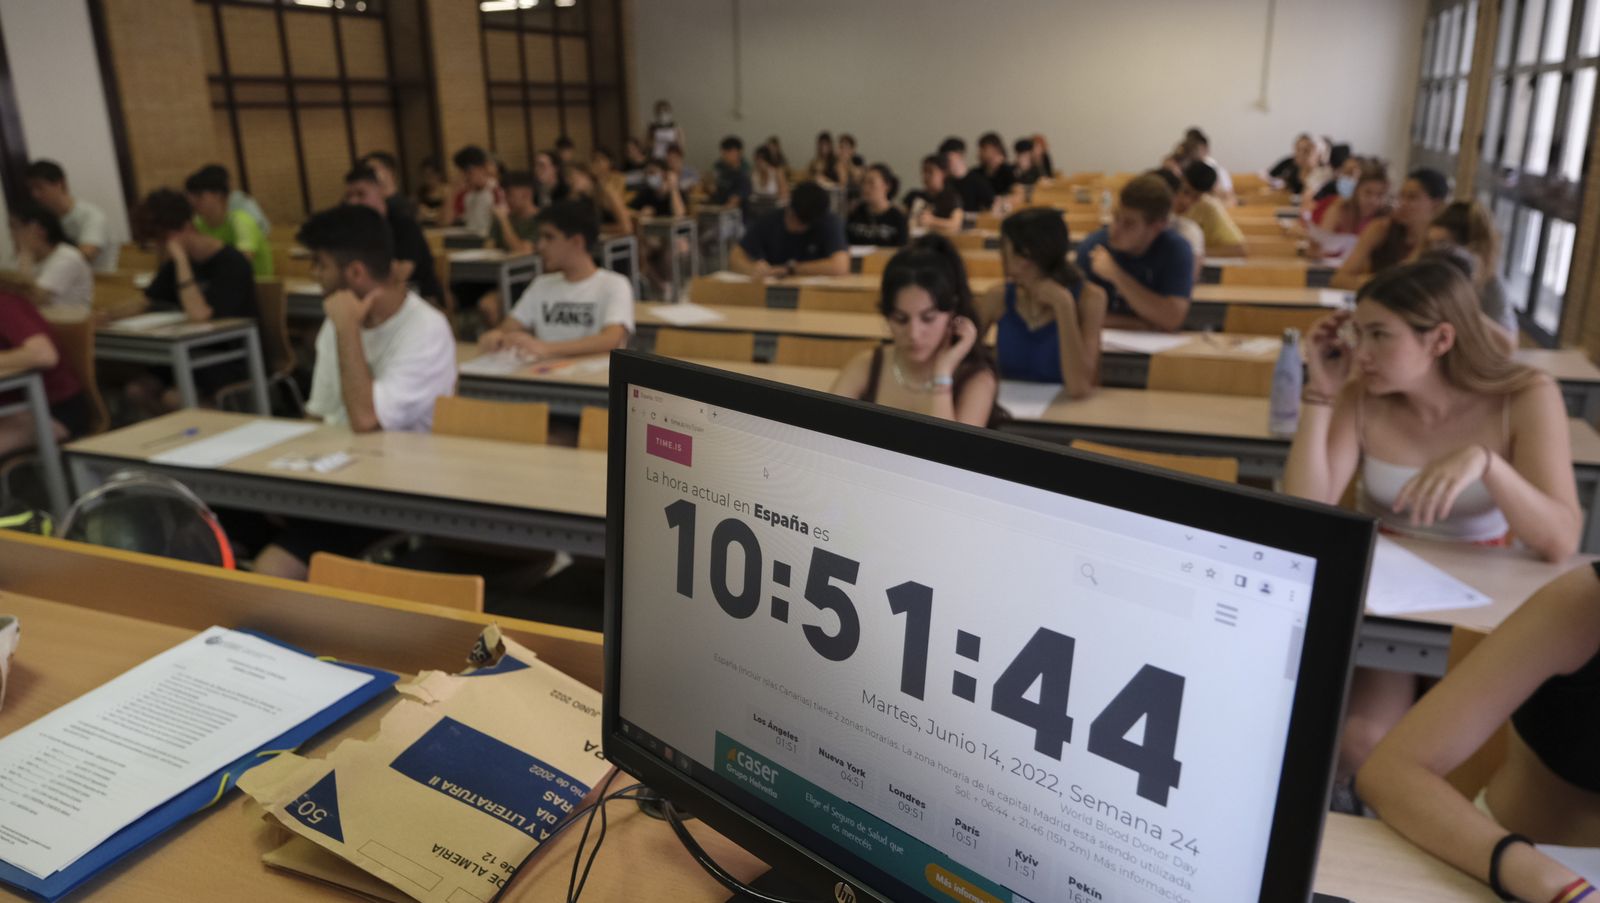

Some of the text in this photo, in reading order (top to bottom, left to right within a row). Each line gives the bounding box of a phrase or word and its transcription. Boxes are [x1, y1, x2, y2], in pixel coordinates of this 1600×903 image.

[543, 302, 595, 327] VANS
[656, 437, 682, 452] TIME.IS
[646, 467, 830, 542] La hora actual en España es
[550, 689, 600, 717] JUNIO 2022
[753, 713, 799, 743] Los Ángeles
[775, 736, 797, 753] 01:51
[528, 764, 556, 782] 2022
[726, 763, 748, 782] Grupo
[737, 750, 780, 785] caser
[818, 747, 866, 778] Nueva York
[862, 689, 1200, 857] Martes, Junio 14, 2022, Semana 24
[556, 775, 570, 788] de
[813, 701, 833, 717] tiene
[834, 711, 839, 721] 2
[840, 715, 864, 733] zonas
[902, 744, 913, 757] La
[914, 753, 935, 768] zona
[937, 762, 970, 784] horaria
[971, 777, 985, 791] de
[986, 784, 995, 796] la
[997, 792, 1031, 813] capital
[1034, 807, 1071, 833] Madrid
[1073, 826, 1096, 845] está
[1100, 839, 1137, 864] siendo
[840, 771, 865, 790] 04:51
[440, 779, 527, 827] LITERATURA
[889, 783, 926, 809] Londres
[298, 800, 328, 825] 50
[897, 801, 924, 821] 09:51
[525, 822, 537, 834] Y
[831, 823, 841, 833] os
[831, 807, 857, 828] Seguro
[856, 819, 867, 833] de
[867, 828, 888, 846] Salud
[889, 841, 904, 855] que
[951, 828, 978, 850] 10:51
[980, 798, 1008, 818] 06:44
[1019, 816, 1044, 837] 21:46
[1046, 829, 1067, 848] (15h
[1069, 841, 1091, 860] 2m)
[1093, 853, 1117, 872] Más
[1060, 802, 1198, 876] World Blood Donor Day
[431, 843, 487, 877] ALMERÍA
[481, 851, 497, 865] 12
[1007, 857, 1036, 880] 11:51
[1015, 849, 1040, 868] Kyiv
[935, 873, 952, 889] Más
